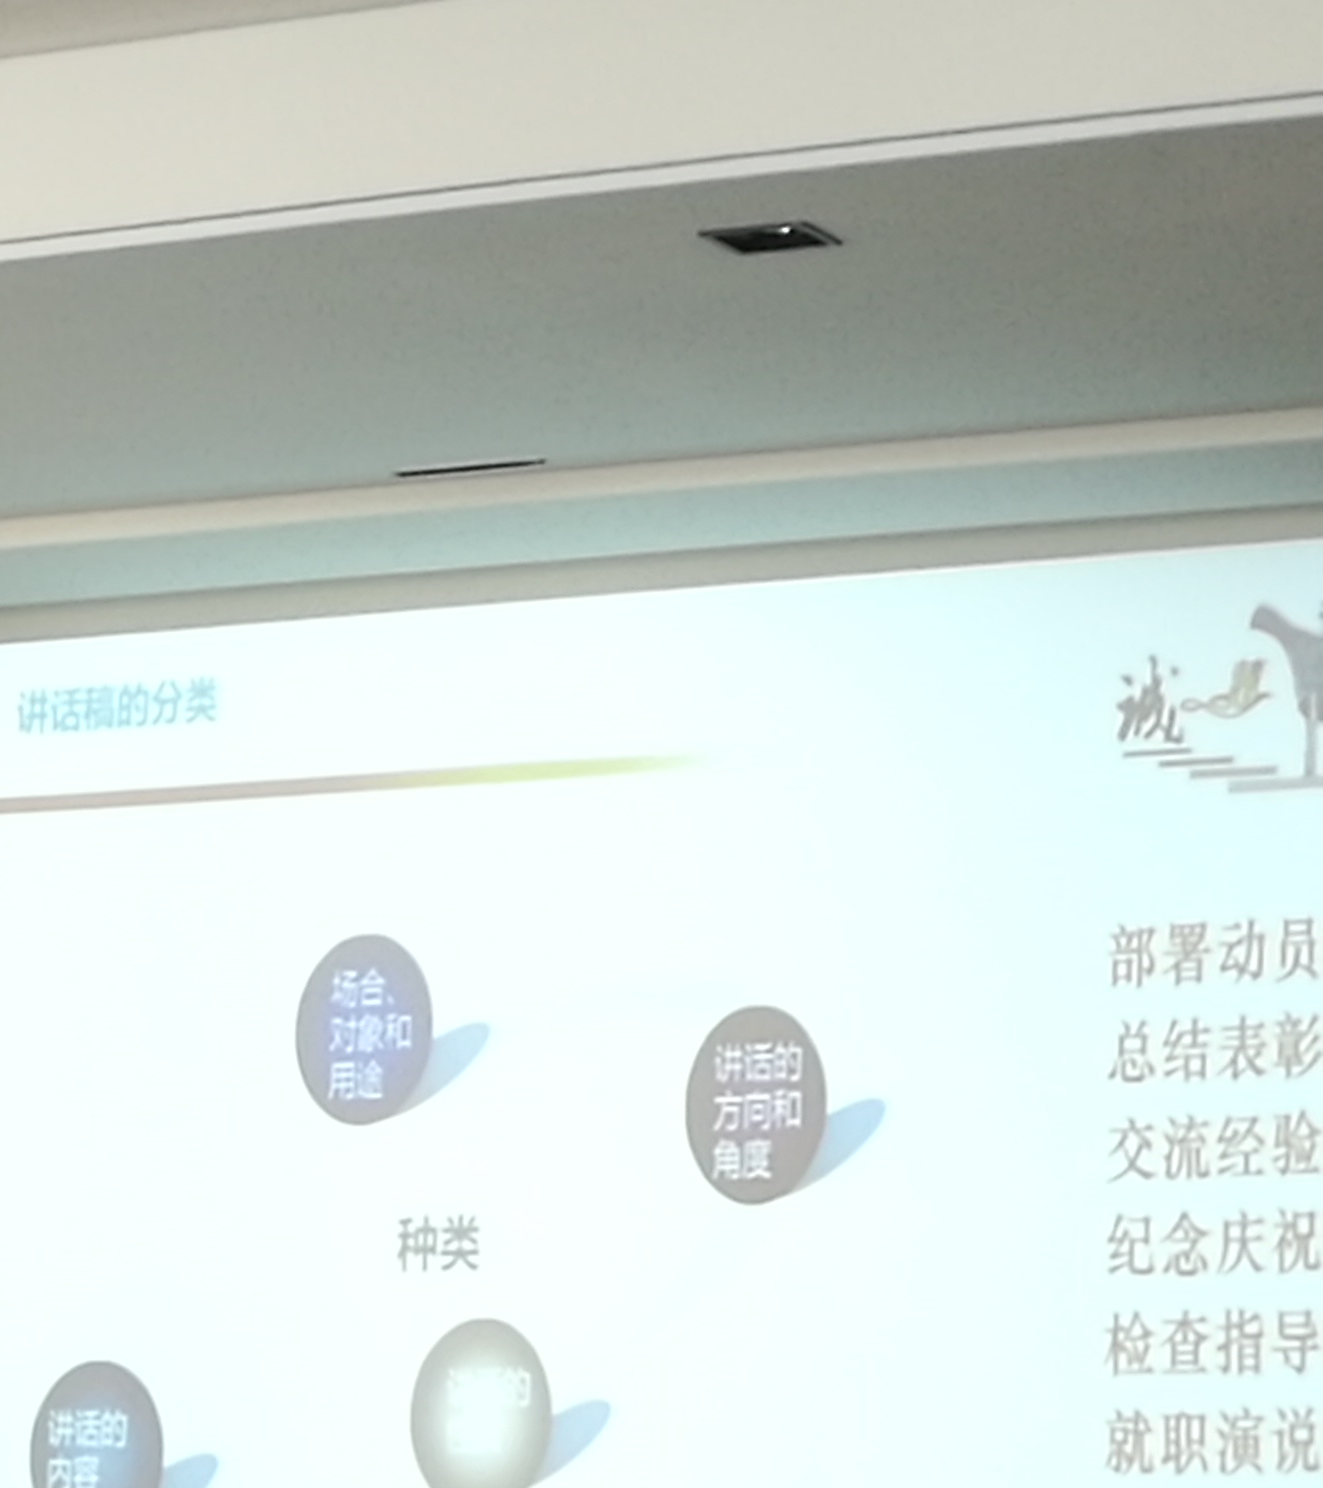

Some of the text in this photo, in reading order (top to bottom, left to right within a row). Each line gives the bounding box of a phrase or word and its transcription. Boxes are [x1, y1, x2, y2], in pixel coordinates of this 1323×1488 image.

[16, 676, 218, 735] 讲话稿的分类
[1108, 916, 1321, 989] 部署动员
[328, 1013, 413, 1053] 对象和
[713, 1042, 804, 1084] 讲话的
[1107, 1012, 1322, 1083] 总结表彰
[327, 1060, 386, 1101] 用途
[712, 1089, 804, 1132] 方向和
[712, 1139, 773, 1182] 角度
[1107, 1110, 1322, 1183] 交流经验
[396, 1213, 481, 1274] 种类
[1106, 1208, 1322, 1277] 纪念庆祝
[1104, 1308, 1321, 1377] 检查指导
[46, 1408, 129, 1451] 讲话的
[1104, 1406, 1321, 1476] 就职演说
